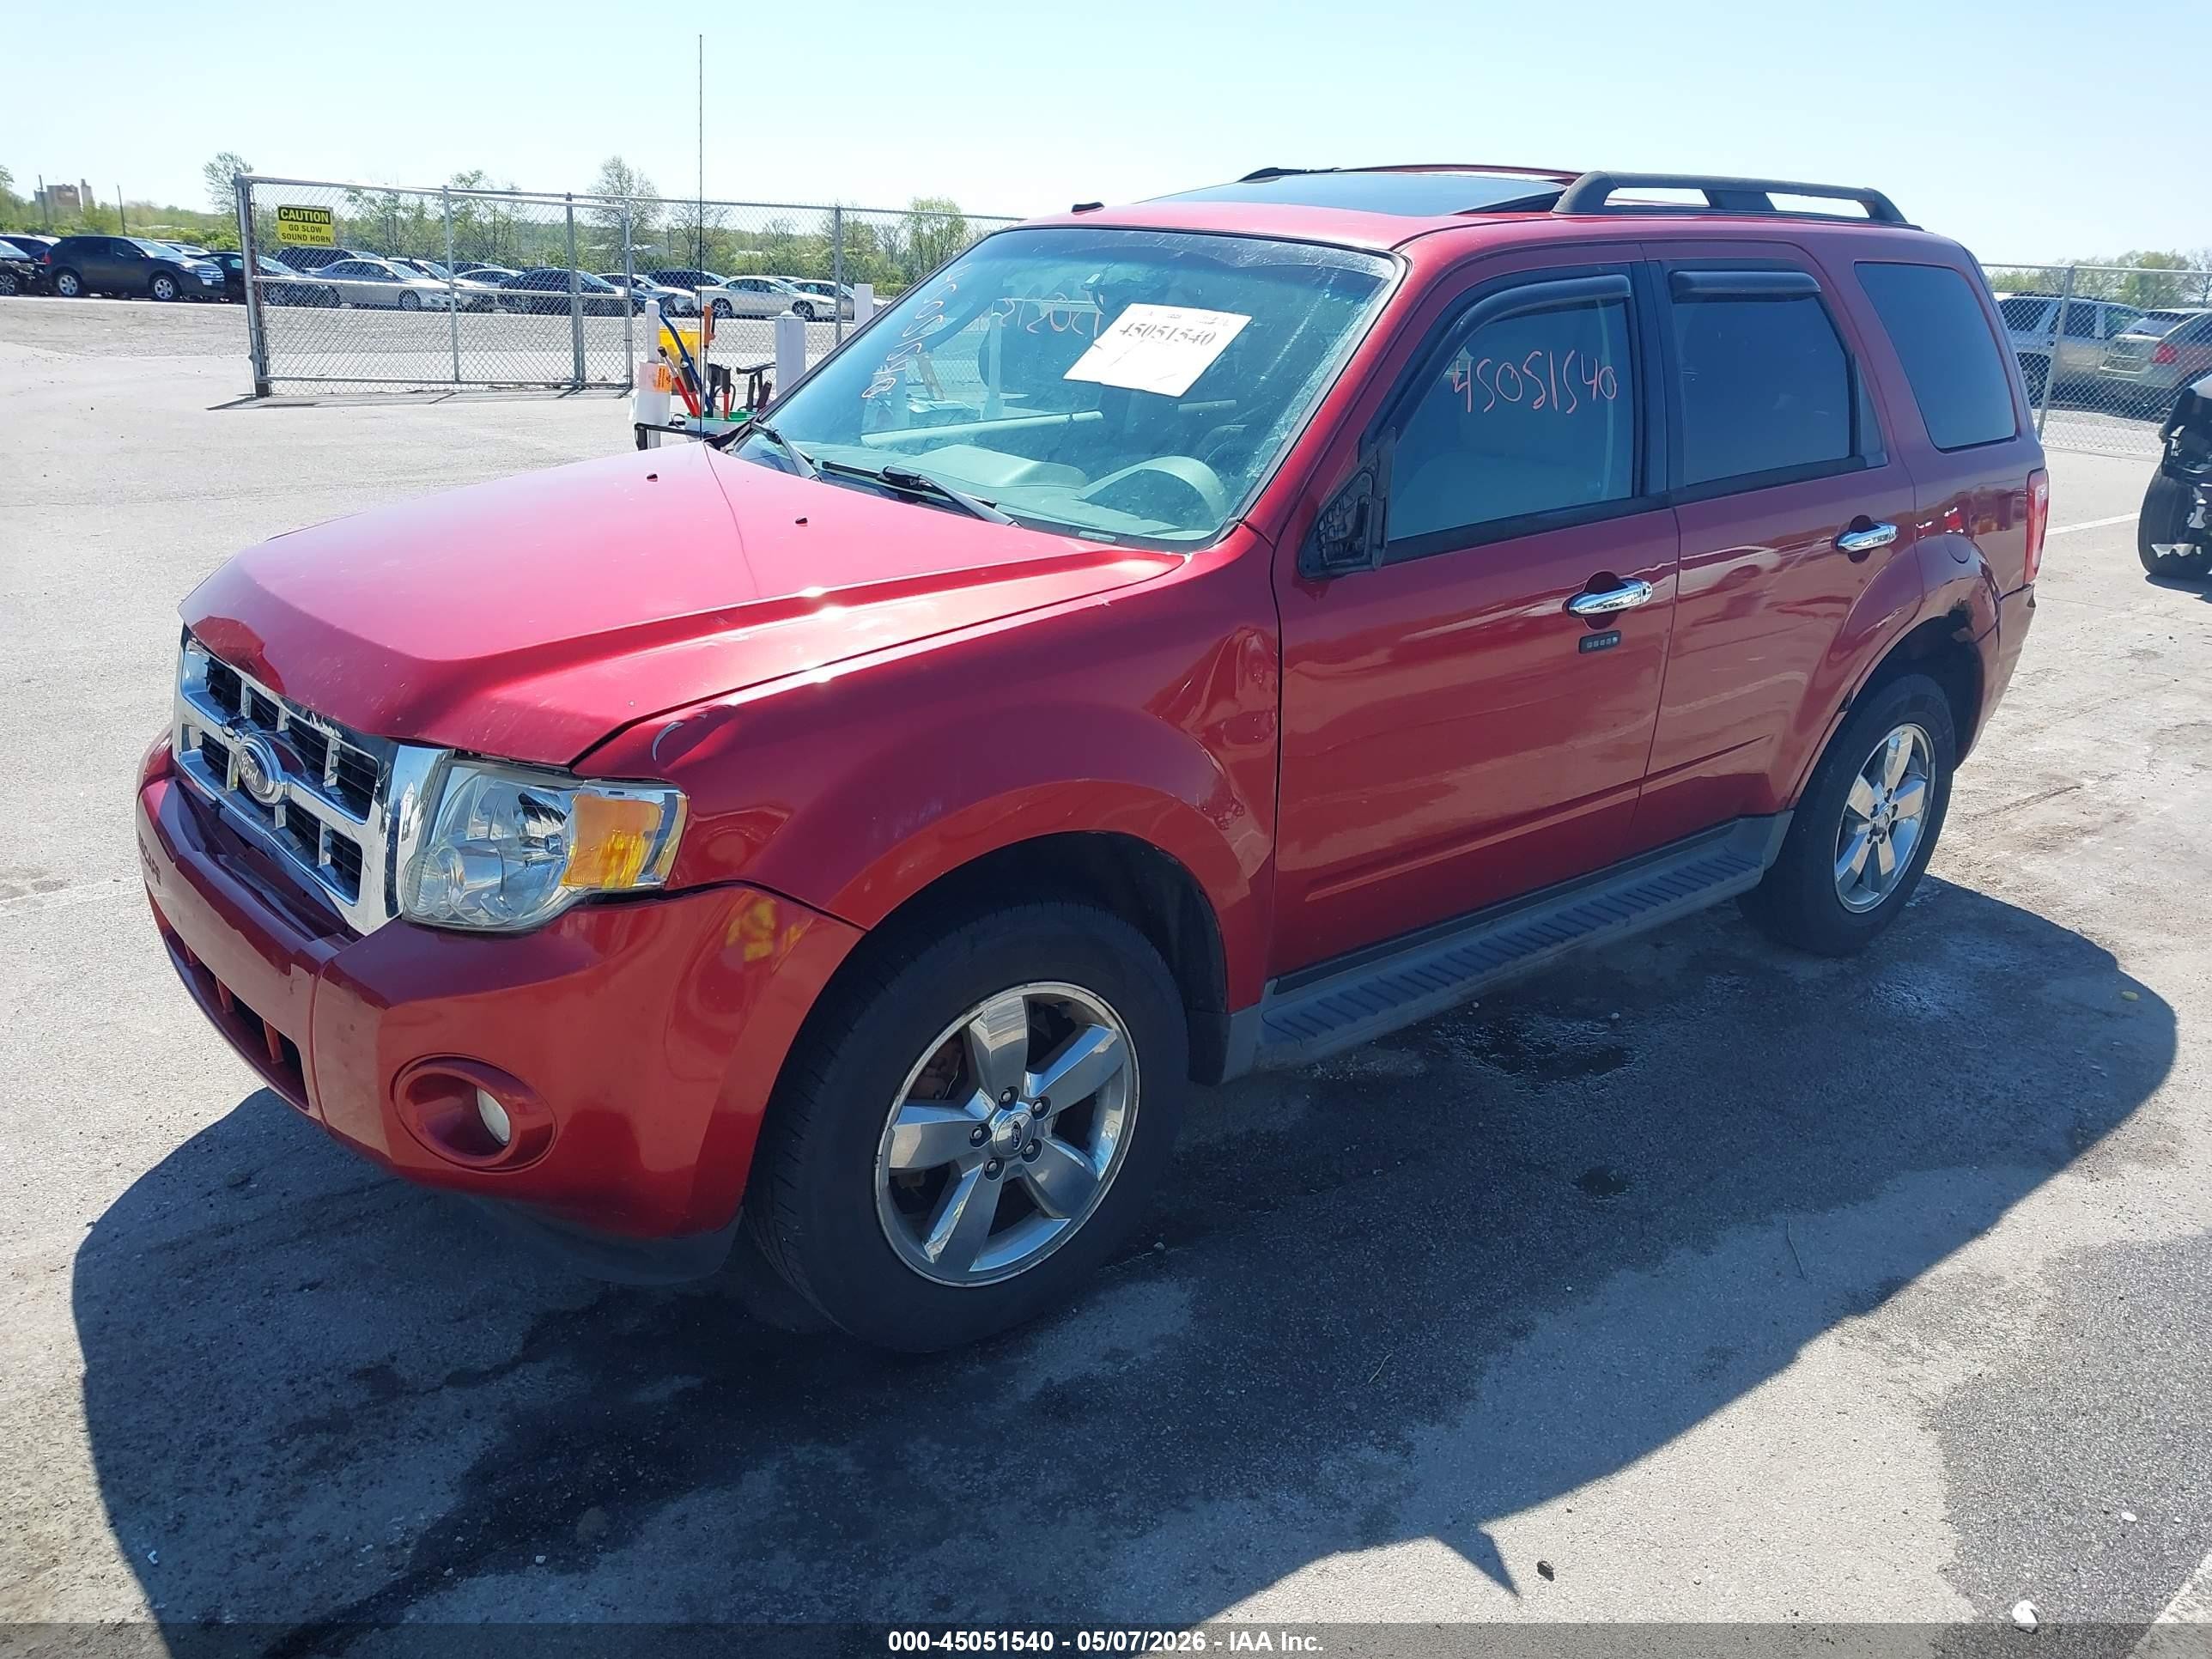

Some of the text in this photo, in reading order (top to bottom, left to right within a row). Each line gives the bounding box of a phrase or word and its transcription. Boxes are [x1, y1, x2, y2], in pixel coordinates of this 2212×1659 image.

[280, 209, 330, 223] CAUTION
[282, 232, 331, 243] SOUND HORN
[301, 225, 323, 234] SLOW
[1119, 322, 1218, 346] 45051540
[1453, 349, 1618, 414] 45051540
[240, 751, 260, 787] Ford
